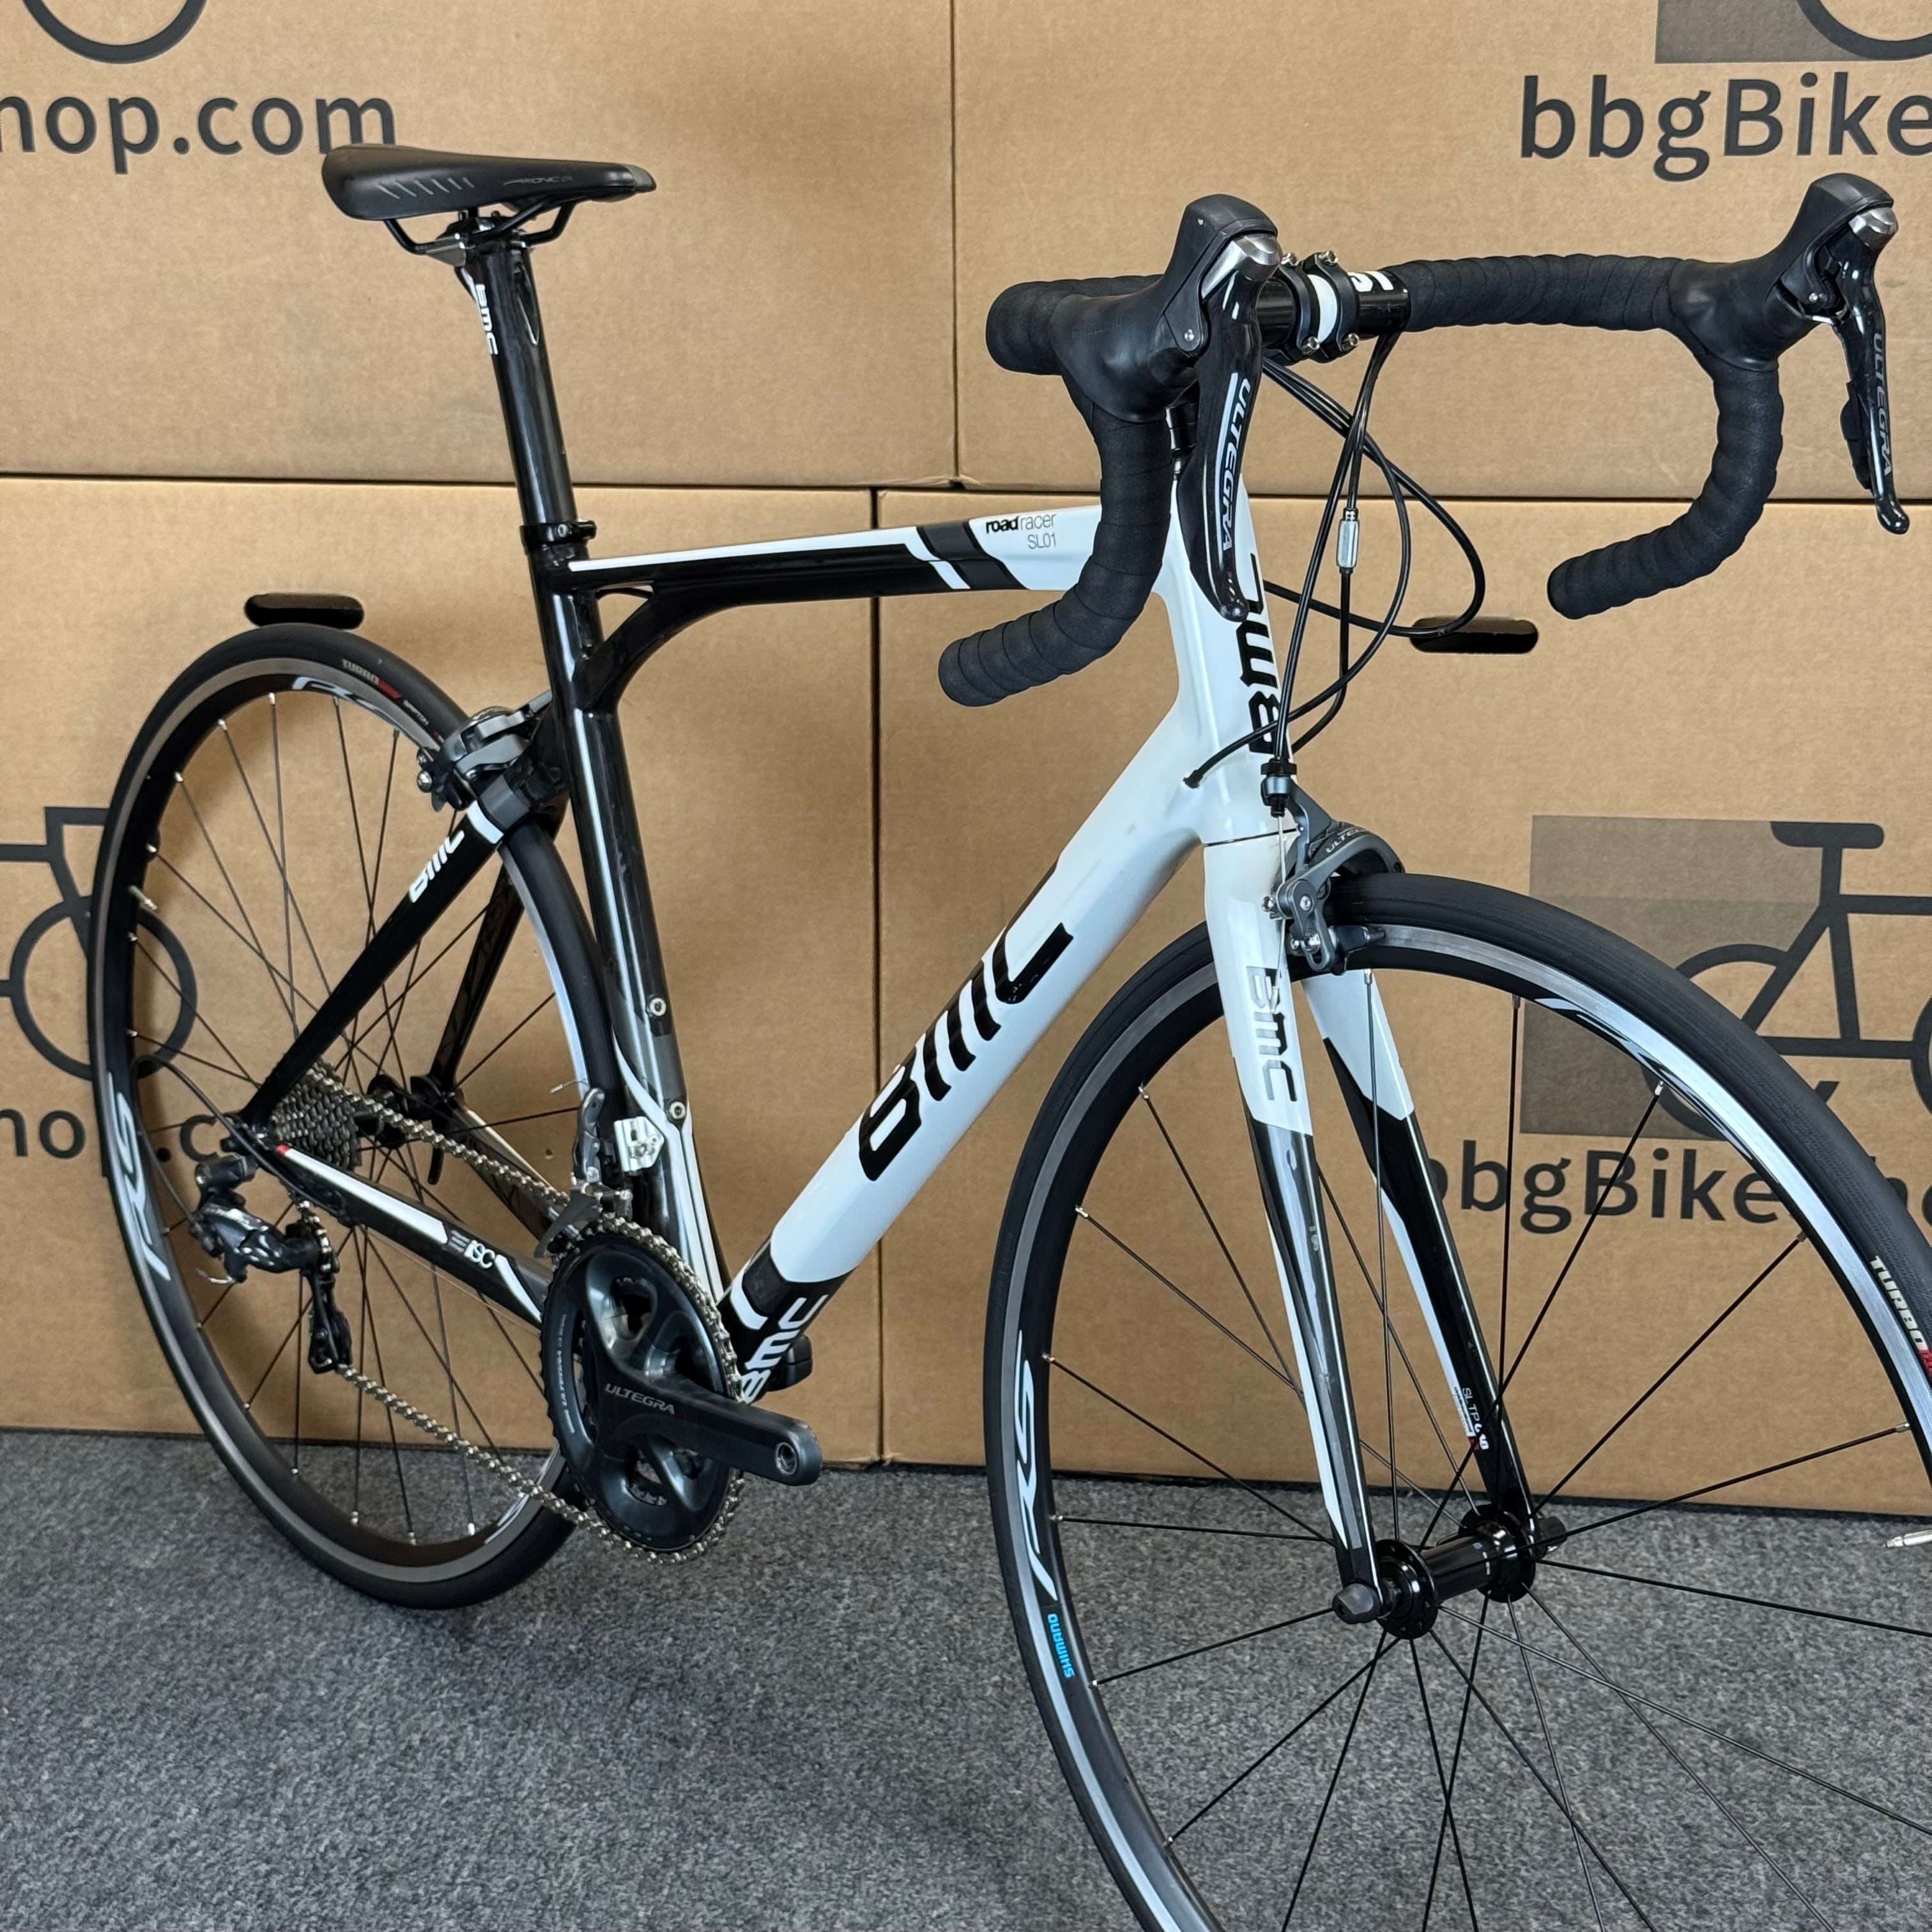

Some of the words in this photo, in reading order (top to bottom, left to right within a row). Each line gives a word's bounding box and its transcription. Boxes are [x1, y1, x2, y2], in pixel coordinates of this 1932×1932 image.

[1521, 71, 1932, 182] bbgBike
[1873, 333, 1892, 475] ULTEGRA
[1222, 378, 1251, 551] ULTEGRA
[1027, 532, 1057, 549] SL01
[1870, 1255, 1928, 1351] TURBO
[604, 1383, 675, 1415] ULTEGRA
[1047, 1613, 1076, 1679] SHIMANO
